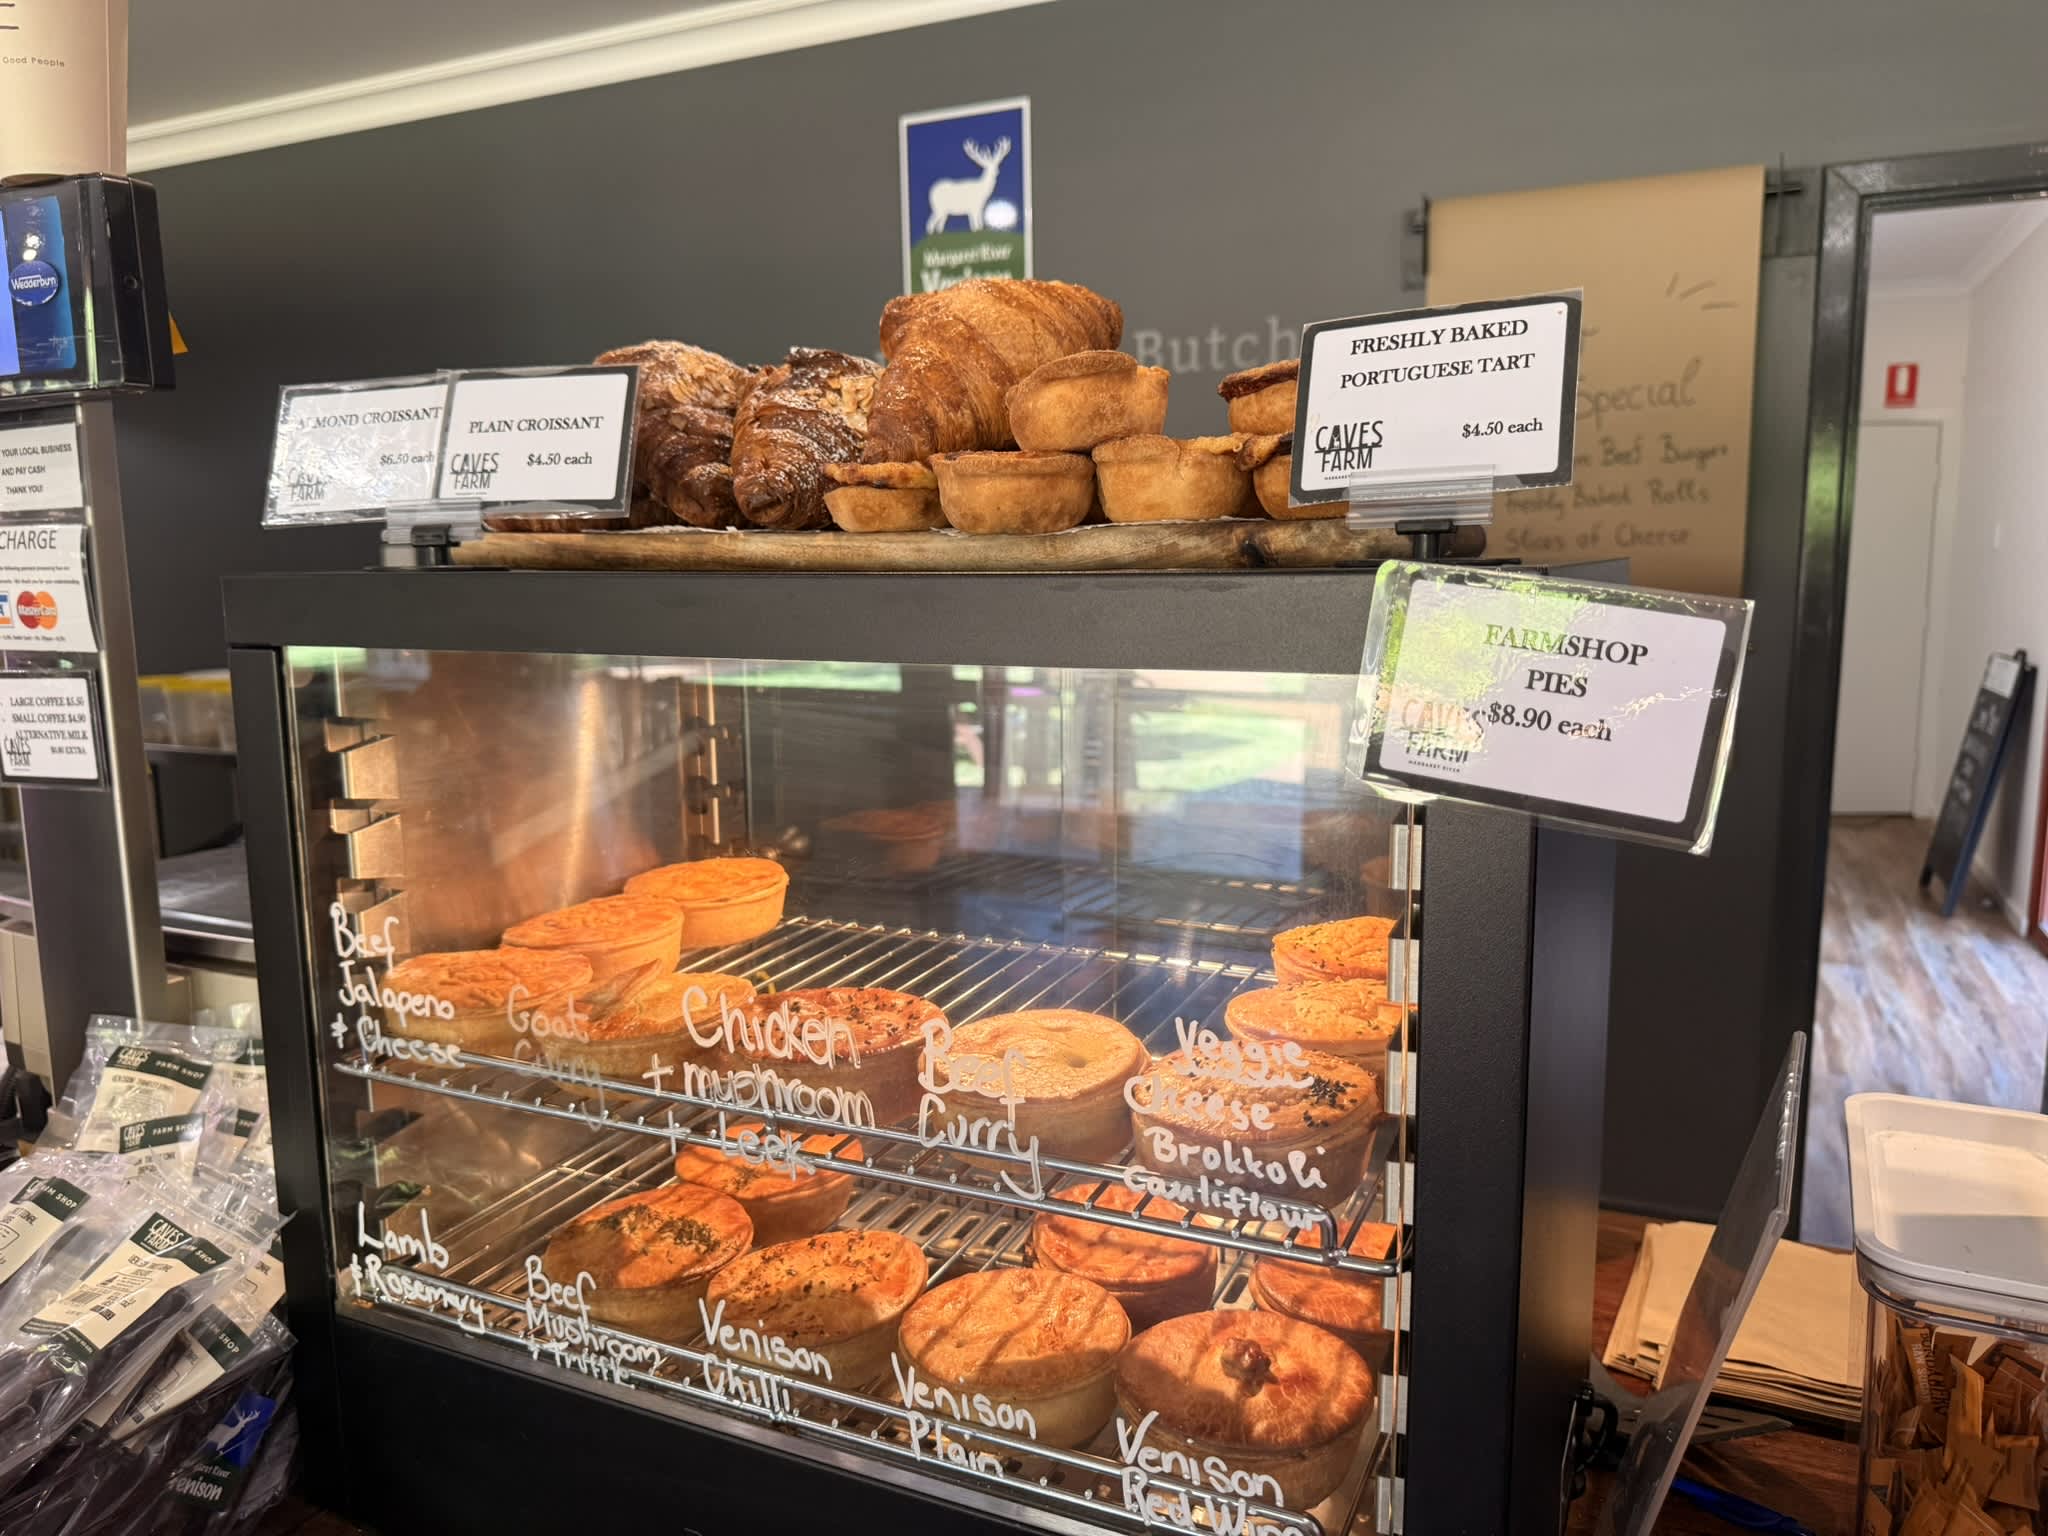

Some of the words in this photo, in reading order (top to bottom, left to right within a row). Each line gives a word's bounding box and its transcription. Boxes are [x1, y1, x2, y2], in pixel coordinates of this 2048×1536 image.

[2, 56, 27, 64] Good
[31, 57, 65, 67] People
[1350, 328, 1446, 355] FRESHLY
[1449, 319, 1529, 343] BAKED
[1340, 360, 1473, 388] PORTUGUESE
[1478, 353, 1536, 373] TART
[362, 407, 443, 425] CROISSANT
[469, 420, 514, 433] PLAIN
[517, 416, 604, 431] CROISSANT
[1462, 421, 1503, 439] $4.50
[1508, 418, 1543, 433] each
[1, 447, 19, 457] YOUR
[20, 446, 40, 456] LOCAL
[40, 443, 72, 454] BUSINESS
[1315, 420, 1383, 453] CAVES
[1, 467, 15, 476] AND
[28, 465, 46, 475] CASH
[379, 453, 408, 466] $6.50
[411, 451, 434, 464] each
[450, 452, 500, 474] CAVES
[527, 452, 561, 466] $4.50
[564, 452, 592, 465] each
[1321, 448, 1373, 472] FARM
[6, 485, 27, 495] THANK
[454, 472, 491, 489] FARM
[0, 530, 57, 550] CHARGE
[1483, 623, 1648, 666] FARMSHOP
[1525, 668, 1588, 698] PIES
[10, 696, 34, 707] LARGE
[35, 696, 65, 707] COFFEE
[12, 713, 37, 723] SMALL
[38, 713, 66, 723] COFFEE
[16, 730, 65, 740] ALTERNATIVE
[67, 730, 88, 740] MILK
[1487, 701, 1551, 732] $8.90
[1558, 718, 1612, 743] each
[330, 901, 399, 977] Beef
[339, 960, 455, 1028] Jalapeno
[507, 984, 590, 1043] Goat
[682, 985, 861, 1070] Chicken
[356, 1015, 465, 1069] Cheese
[1175, 1016, 1312, 1075] Veggie
[155, 1059, 181, 1072] FARM
[181, 1067, 205, 1080] SHOP
[917, 1017, 1027, 1130] Beef
[642, 1053, 675, 1097] +
[683, 1061, 876, 1130] mushroom
[1123, 1074, 1275, 1131] Cheese
[152, 1126, 174, 1136] FARM
[718, 1111, 816, 1181] Leek
[919, 1093, 1044, 1200] Curry
[1143, 1126, 1328, 1189] Brokkoli
[55, 1192, 78, 1209] SHOP
[150, 1218, 185, 1244] CAVES
[358, 1201, 449, 1270] Lamb
[525, 1255, 597, 1330] Beef
[218, 1332, 240, 1354] SHOP
[525, 1297, 664, 1377] Mushroom
[699, 1297, 833, 1381] Venison
[702, 1352, 791, 1413] Chilli
[891, 1352, 1036, 1440] Venison
[906, 1410, 1004, 1478] Plain
[1116, 1410, 1284, 1508] Venison
[1120, 1465, 1198, 1532] Red
